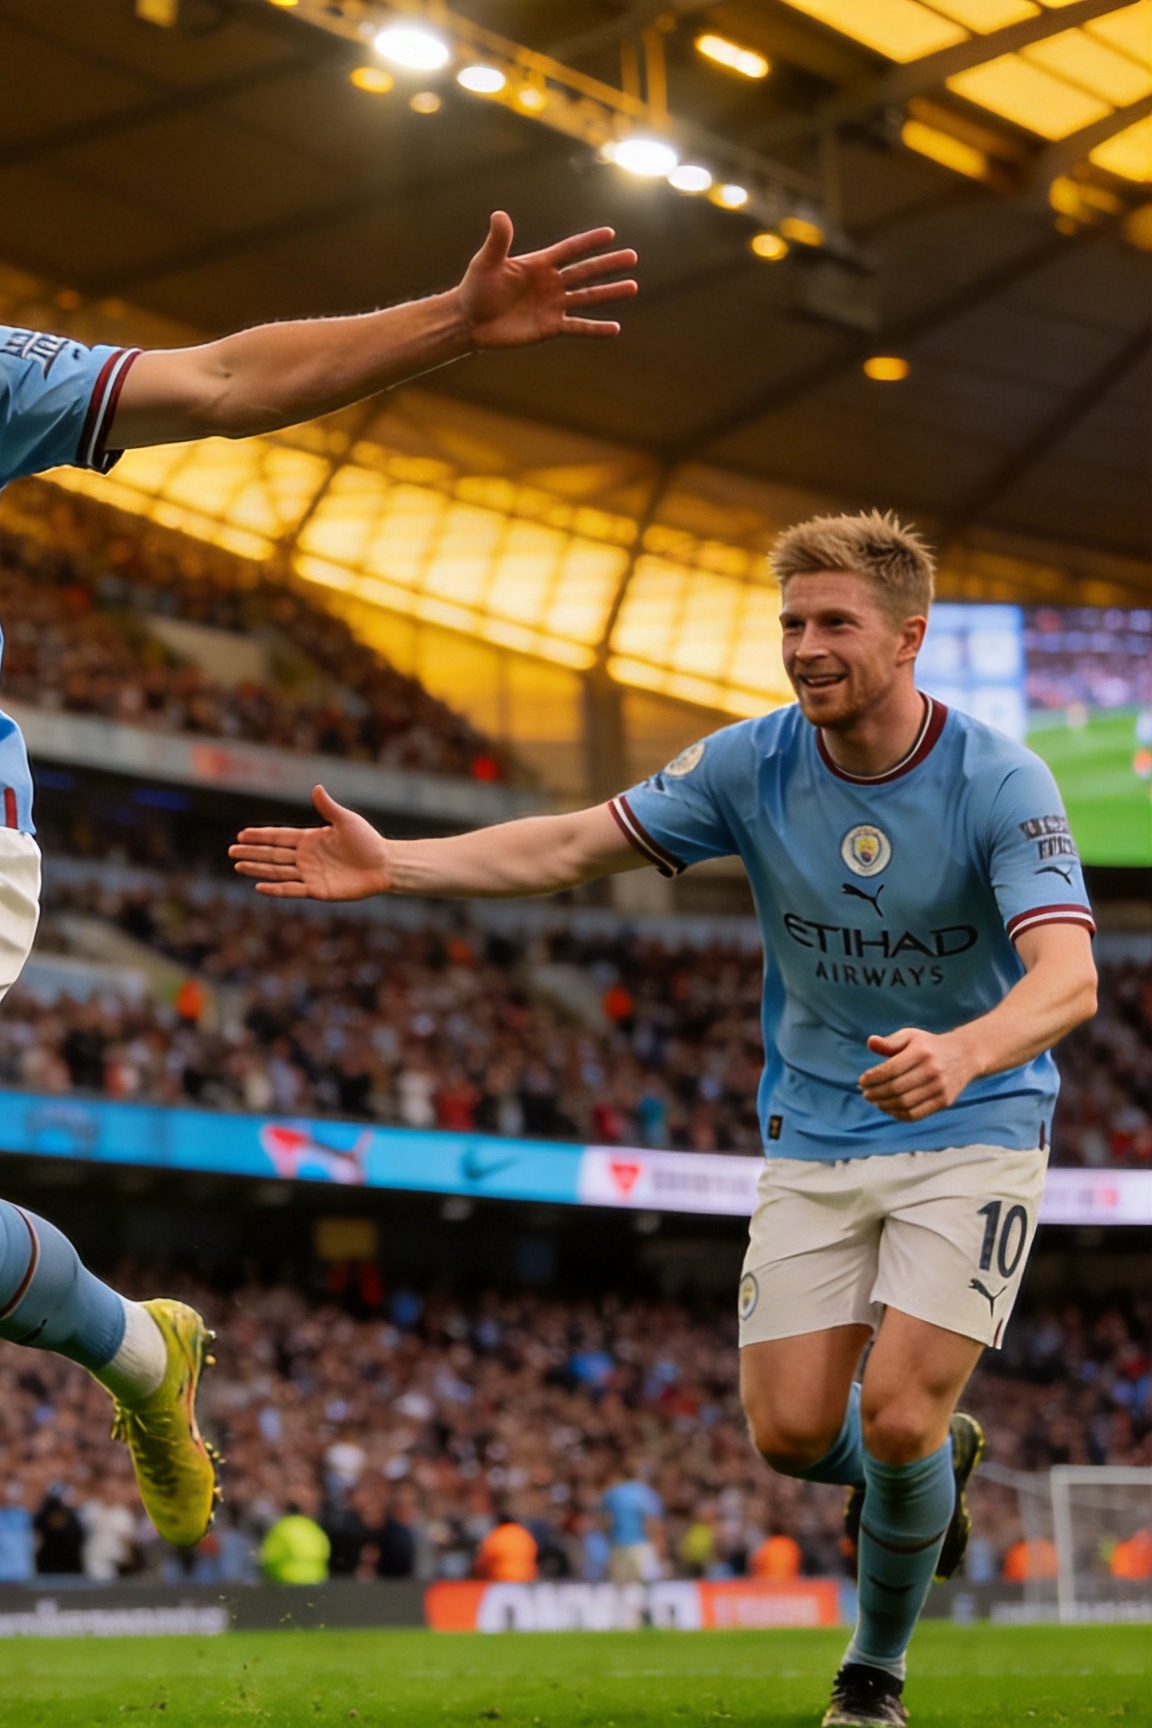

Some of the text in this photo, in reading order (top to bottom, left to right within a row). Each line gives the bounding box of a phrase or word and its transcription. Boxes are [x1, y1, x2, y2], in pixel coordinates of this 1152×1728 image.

[783, 912, 979, 958] ETIHAD
[815, 961, 944, 988] AIRWAYS
[977, 1200, 1028, 1278] 10
